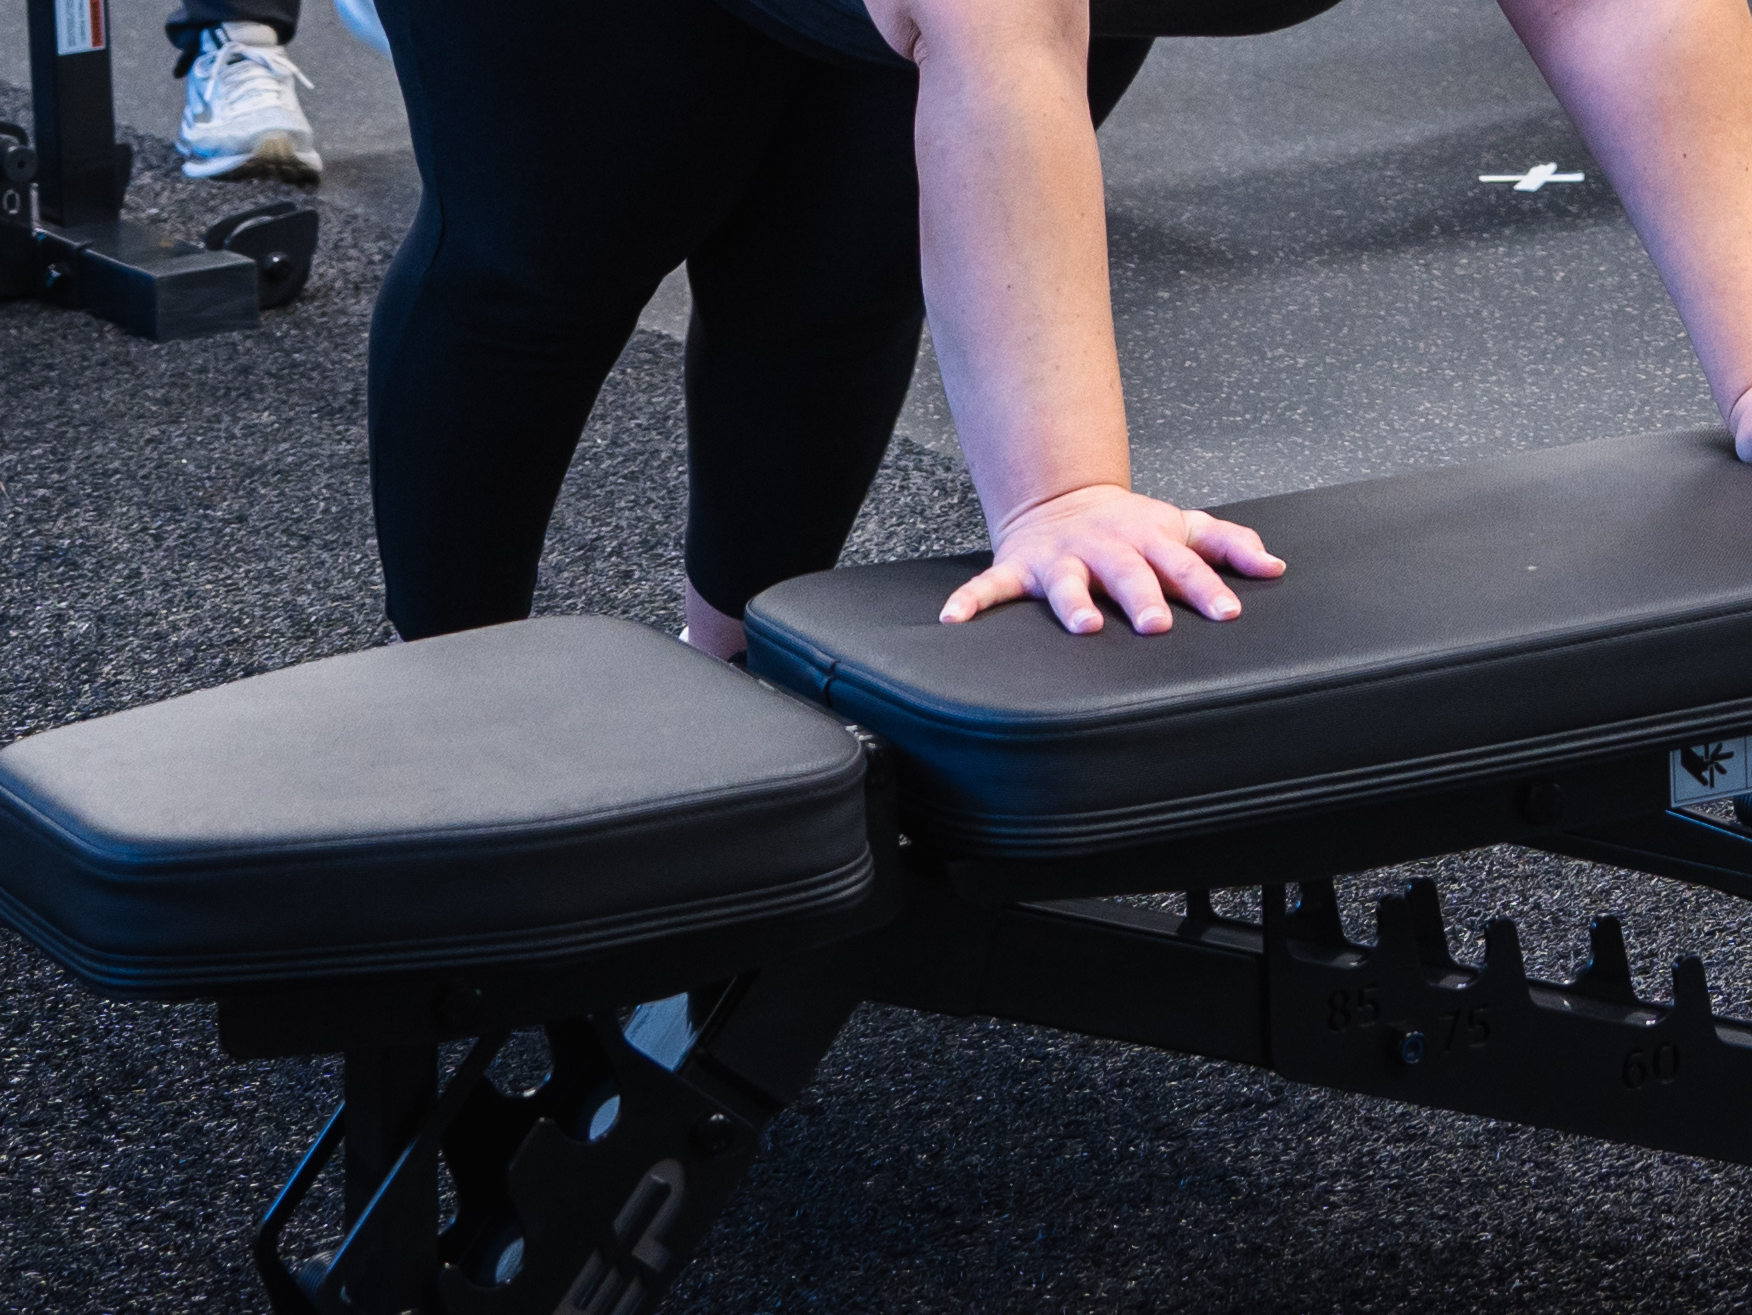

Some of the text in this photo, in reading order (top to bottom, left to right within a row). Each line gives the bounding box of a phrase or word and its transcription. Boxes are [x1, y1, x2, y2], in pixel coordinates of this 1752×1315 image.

[1327, 983, 1381, 1032] 85
[1437, 1004, 1492, 1052] 75
[1622, 1041, 1681, 1090] 60
